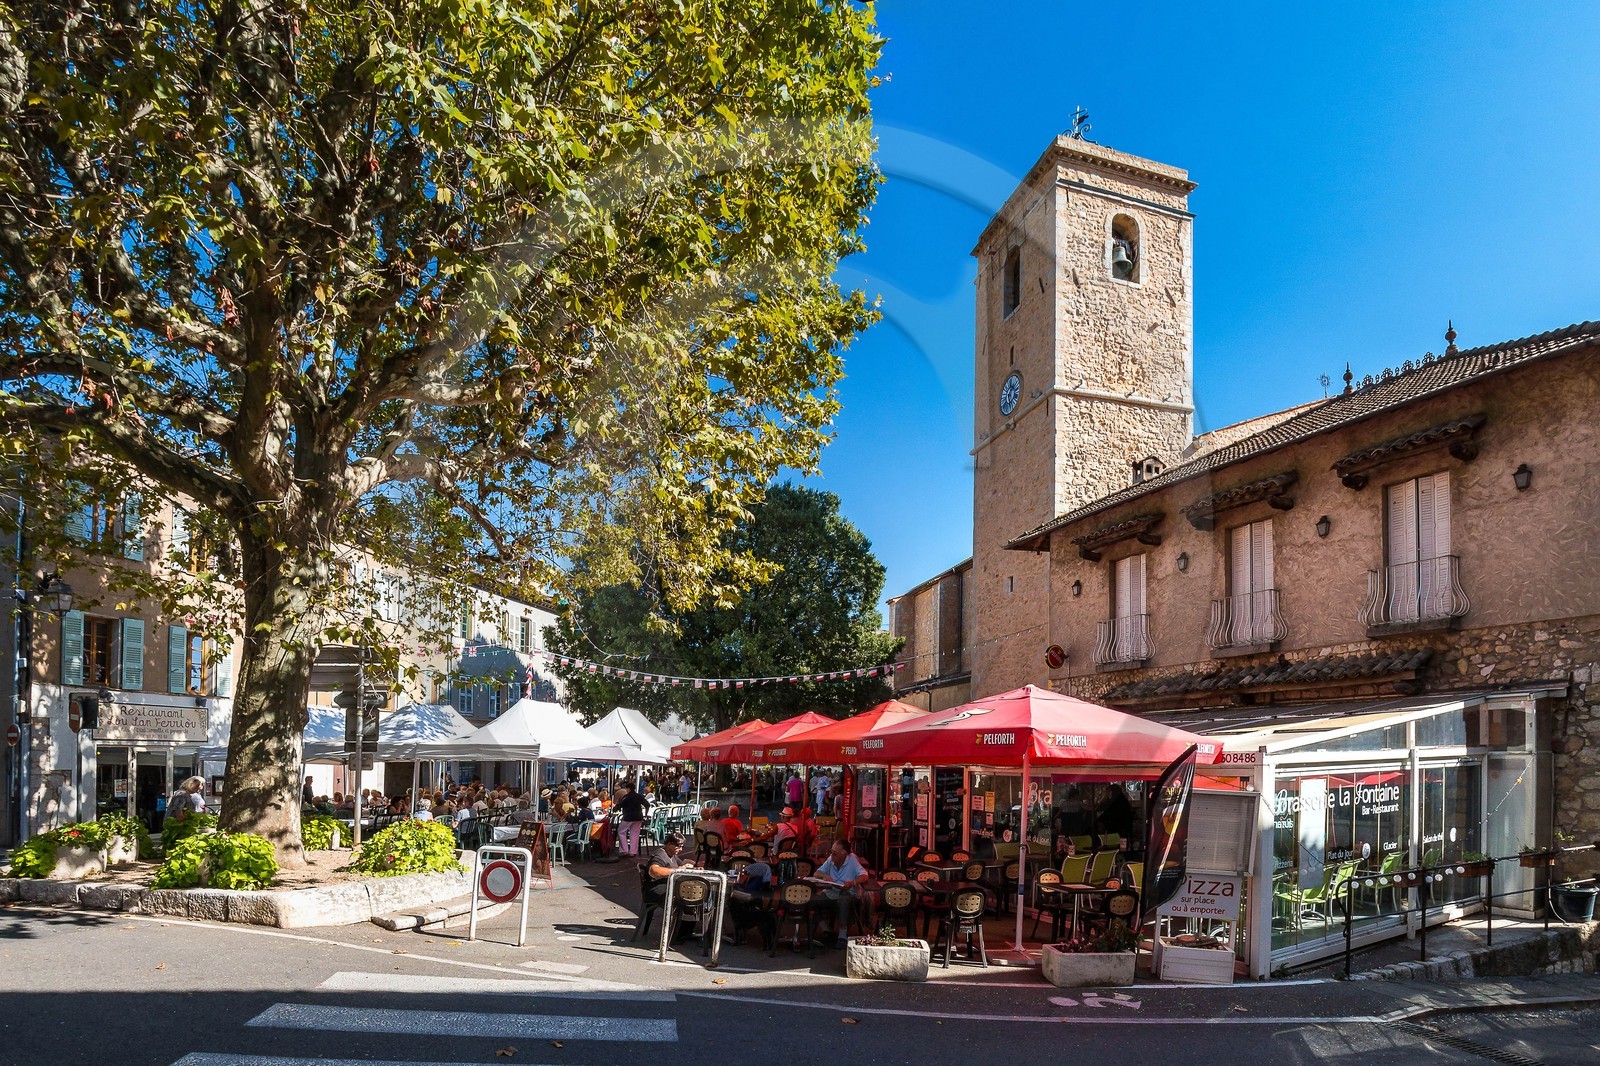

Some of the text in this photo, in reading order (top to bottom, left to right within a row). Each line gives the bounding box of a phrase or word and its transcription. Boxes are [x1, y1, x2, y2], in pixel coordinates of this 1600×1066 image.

[120, 705, 184, 718] Restaurant
[863, 739, 884, 749] PELFORTH
[983, 733, 1015, 745] PELFORTH
[1055, 734, 1087, 747] PELFORTH
[1274, 781, 1400, 816] Brasserie la Fontaine
[1383, 841, 1398, 851] Glacier
[1327, 850, 1337, 860] Plat
[1337, 849, 1344, 859] du
[1193, 896, 1216, 905] place
[1183, 904, 1188, 912] à
[1189, 906, 1226, 915] emporter
